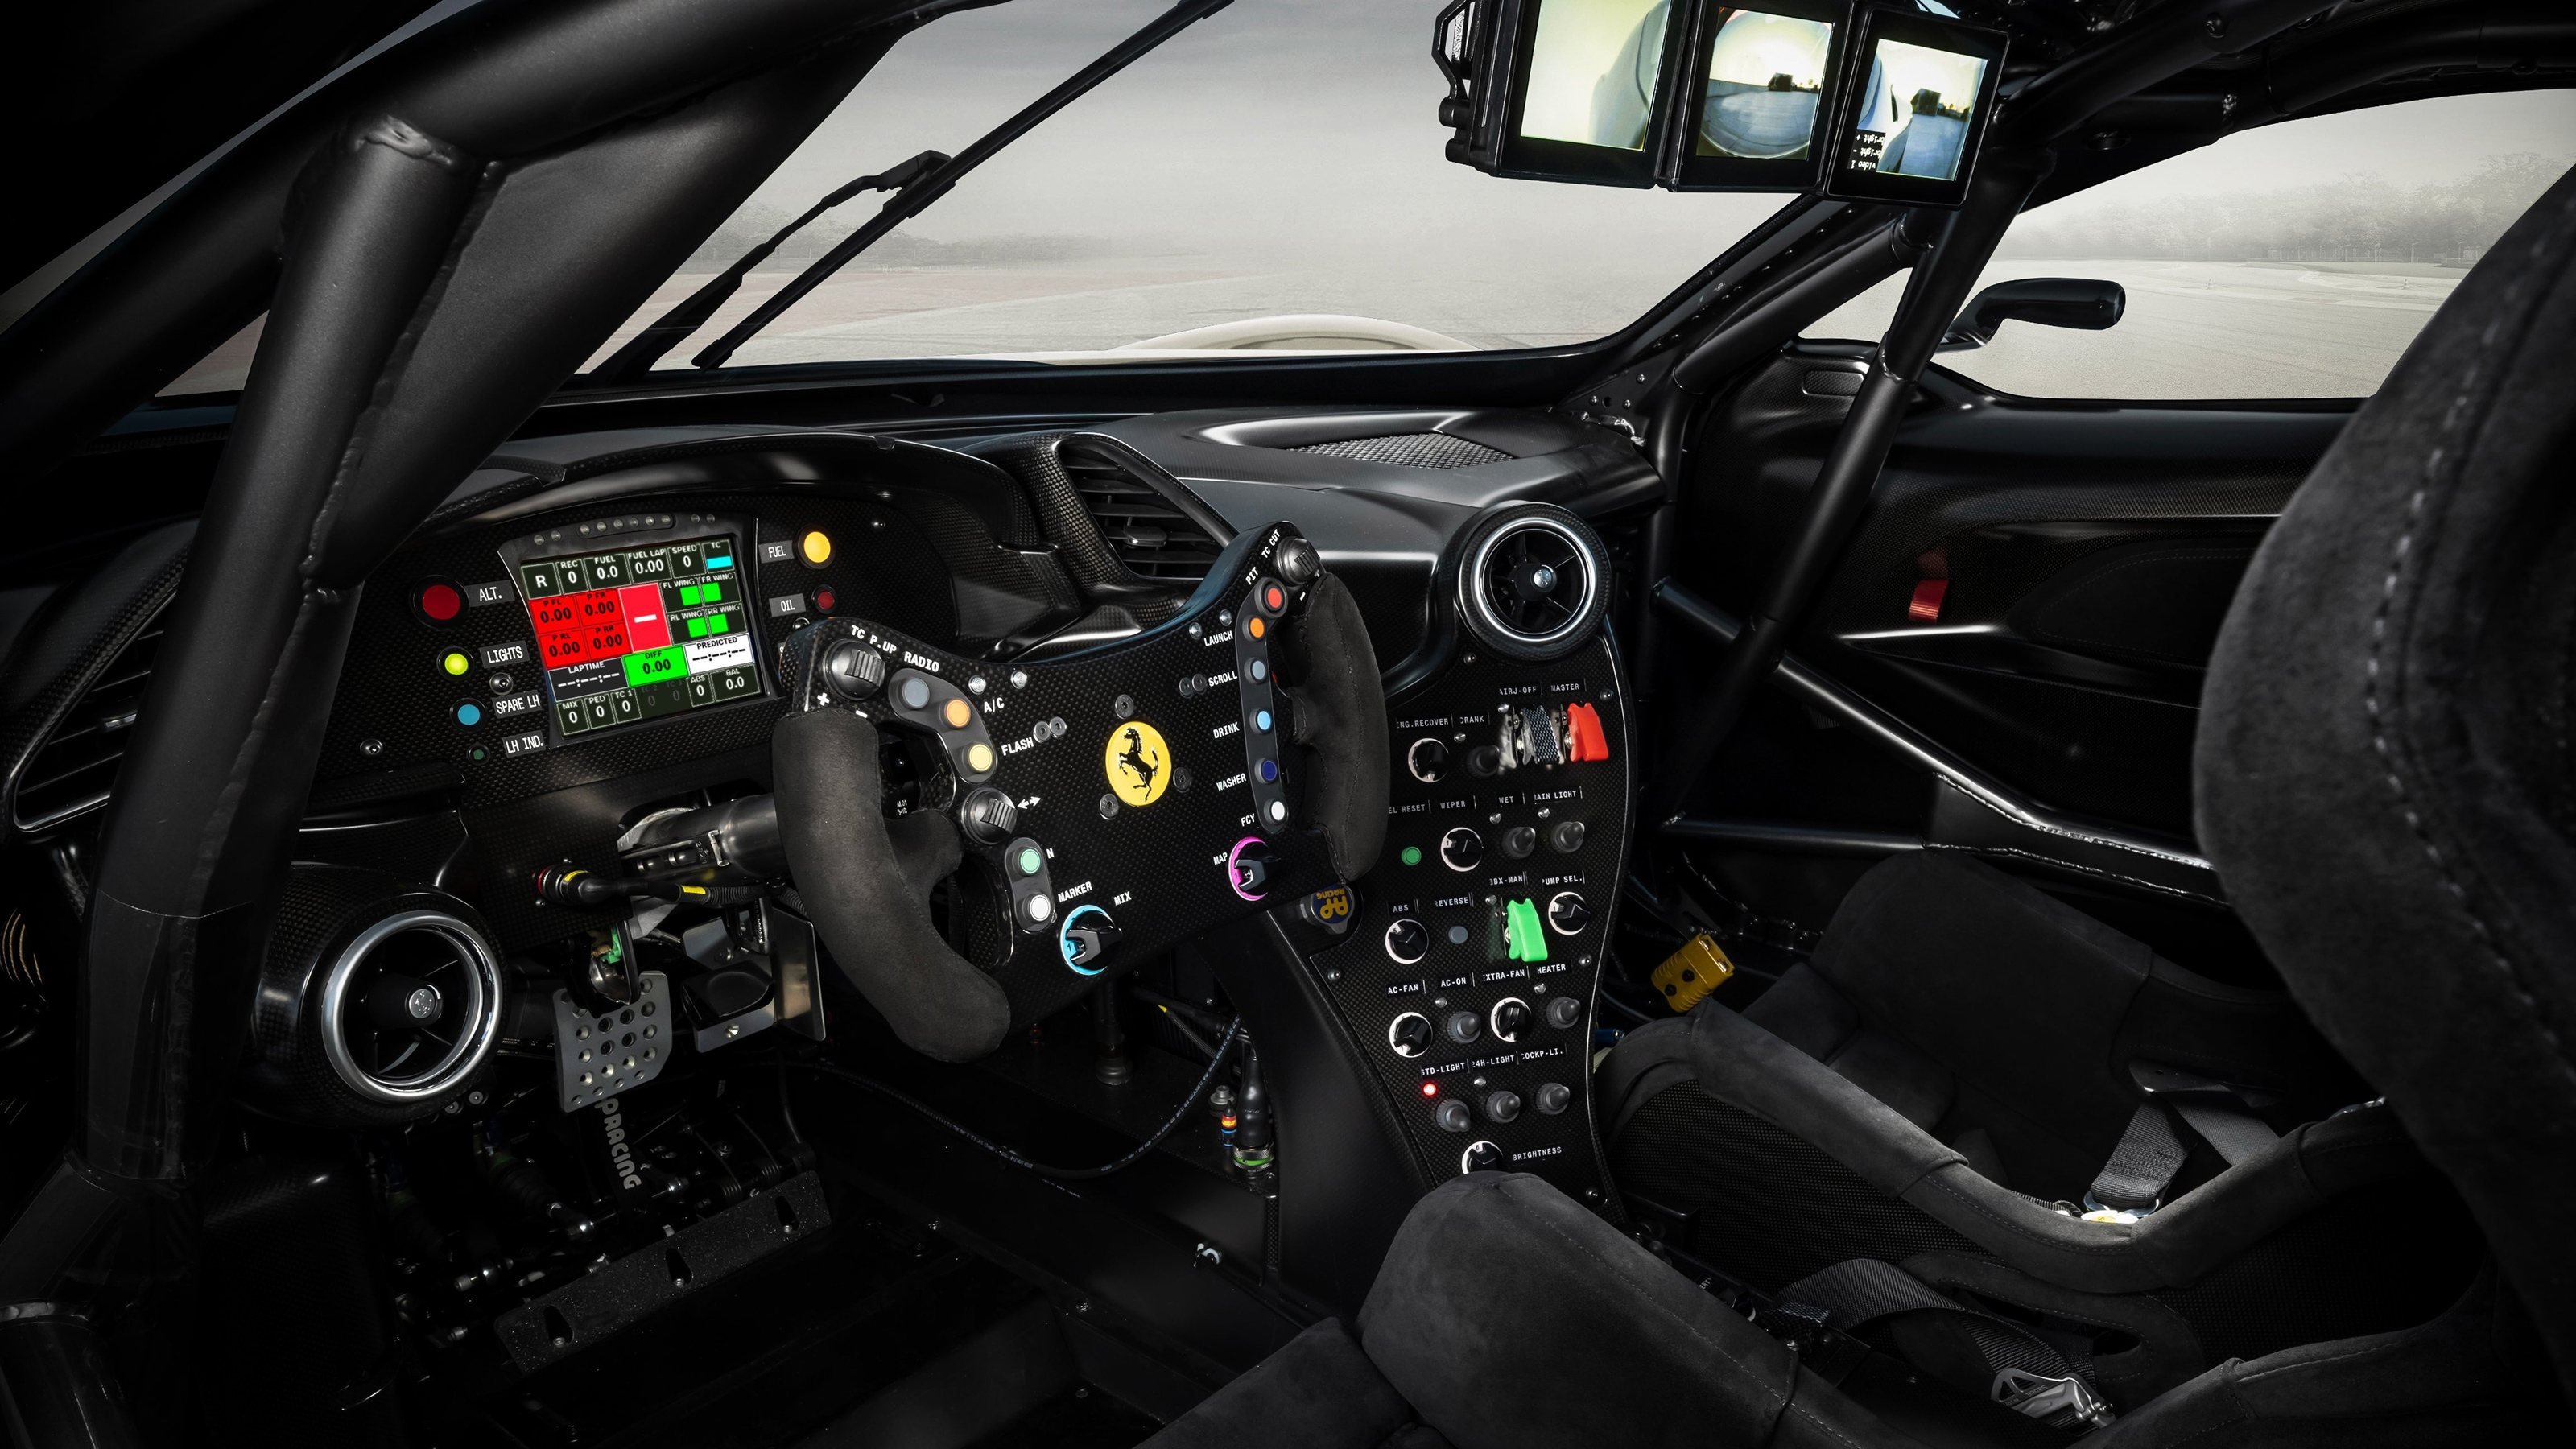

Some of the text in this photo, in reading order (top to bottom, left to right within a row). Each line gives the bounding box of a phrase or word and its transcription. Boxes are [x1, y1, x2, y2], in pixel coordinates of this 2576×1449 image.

[1864, 134, 1885, 146] bright
[1860, 147, 1882, 159] bright
[1858, 161, 1876, 170] video
[672, 545, 696, 554] SPEED
[1261, 529, 1280, 558] TC CUT
[628, 548, 666, 559] FUEL LAP
[768, 546, 786, 558] FUEL
[560, 560, 578, 568] REC
[594, 555, 616, 564] FUEL
[683, 555, 691, 567] 0
[597, 565, 617, 579] 0.0
[635, 559, 663, 574] 0.00
[535, 575, 547, 588] R
[568, 571, 576, 583] 0
[674, 577, 695, 587] WING
[1245, 567, 1258, 585] PIT
[480, 587, 502, 601] ALT.
[584, 601, 614, 616] 0.00
[720, 603, 740, 613] WING
[781, 600, 795, 612] OIL
[540, 608, 572, 623] 0.00
[681, 609, 702, 619] WING
[852, 625, 865, 639] TC
[1204, 630, 1233, 646] LAUNCH
[593, 634, 622, 650] 0.00
[696, 637, 737, 650] PREDICTED
[869, 634, 897, 654] P.UP
[487, 646, 523, 663] LIGHTS
[549, 642, 580, 657] 0.00
[645, 650, 662, 659] DIFF
[642, 659, 671, 674] 0.00
[904, 651, 939, 672] RADIO
[568, 662, 605, 674] LAPTIME
[691, 675, 705, 683] ABS
[726, 676, 744, 690] 0.0
[1208, 671, 1237, 687] SCROLL
[696, 685, 704, 696] 0
[1500, 687, 1536, 695] AIRJ-OFF
[496, 695, 540, 714] SPARE LH
[563, 701, 579, 709] MIX
[588, 696, 605, 704] PED
[622, 700, 630, 712] 0
[985, 697, 1004, 713] A/C
[569, 712, 577, 723] 0
[596, 706, 605, 717] 0
[1460, 716, 1484, 724] CRANK
[1213, 722, 1240, 738] DRINK
[506, 735, 543, 753] LH IND.
[1001, 737, 1034, 756] FLASH
[1216, 773, 1246, 791] WASHER
[1554, 791, 1576, 799] LIGHT
[1402, 804, 1425, 812] RESET
[1440, 801, 1465, 809] WIPER
[1241, 813, 1254, 827] FCY
[1046, 848, 1054, 859] N
[1213, 852, 1228, 865] MAP
[1490, 875, 1522, 885] GBX-MAN
[1058, 881, 1092, 902] MARKER
[1316, 888, 1345, 899] RACING
[1114, 891, 1132, 906] MIX
[1435, 897, 1468, 906] REVERSE
[1320, 895, 1348, 919] AP
[1393, 904, 1408, 912] ABS
[1538, 964, 1566, 974] HEATER
[1441, 977, 1466, 987] AC-ON
[1388, 984, 1418, 994] AC-FAN
[1421, 1063, 1464, 1075] STD-LIGHT
[1513, 1146, 1561, 1161] BRIGHTNESS
